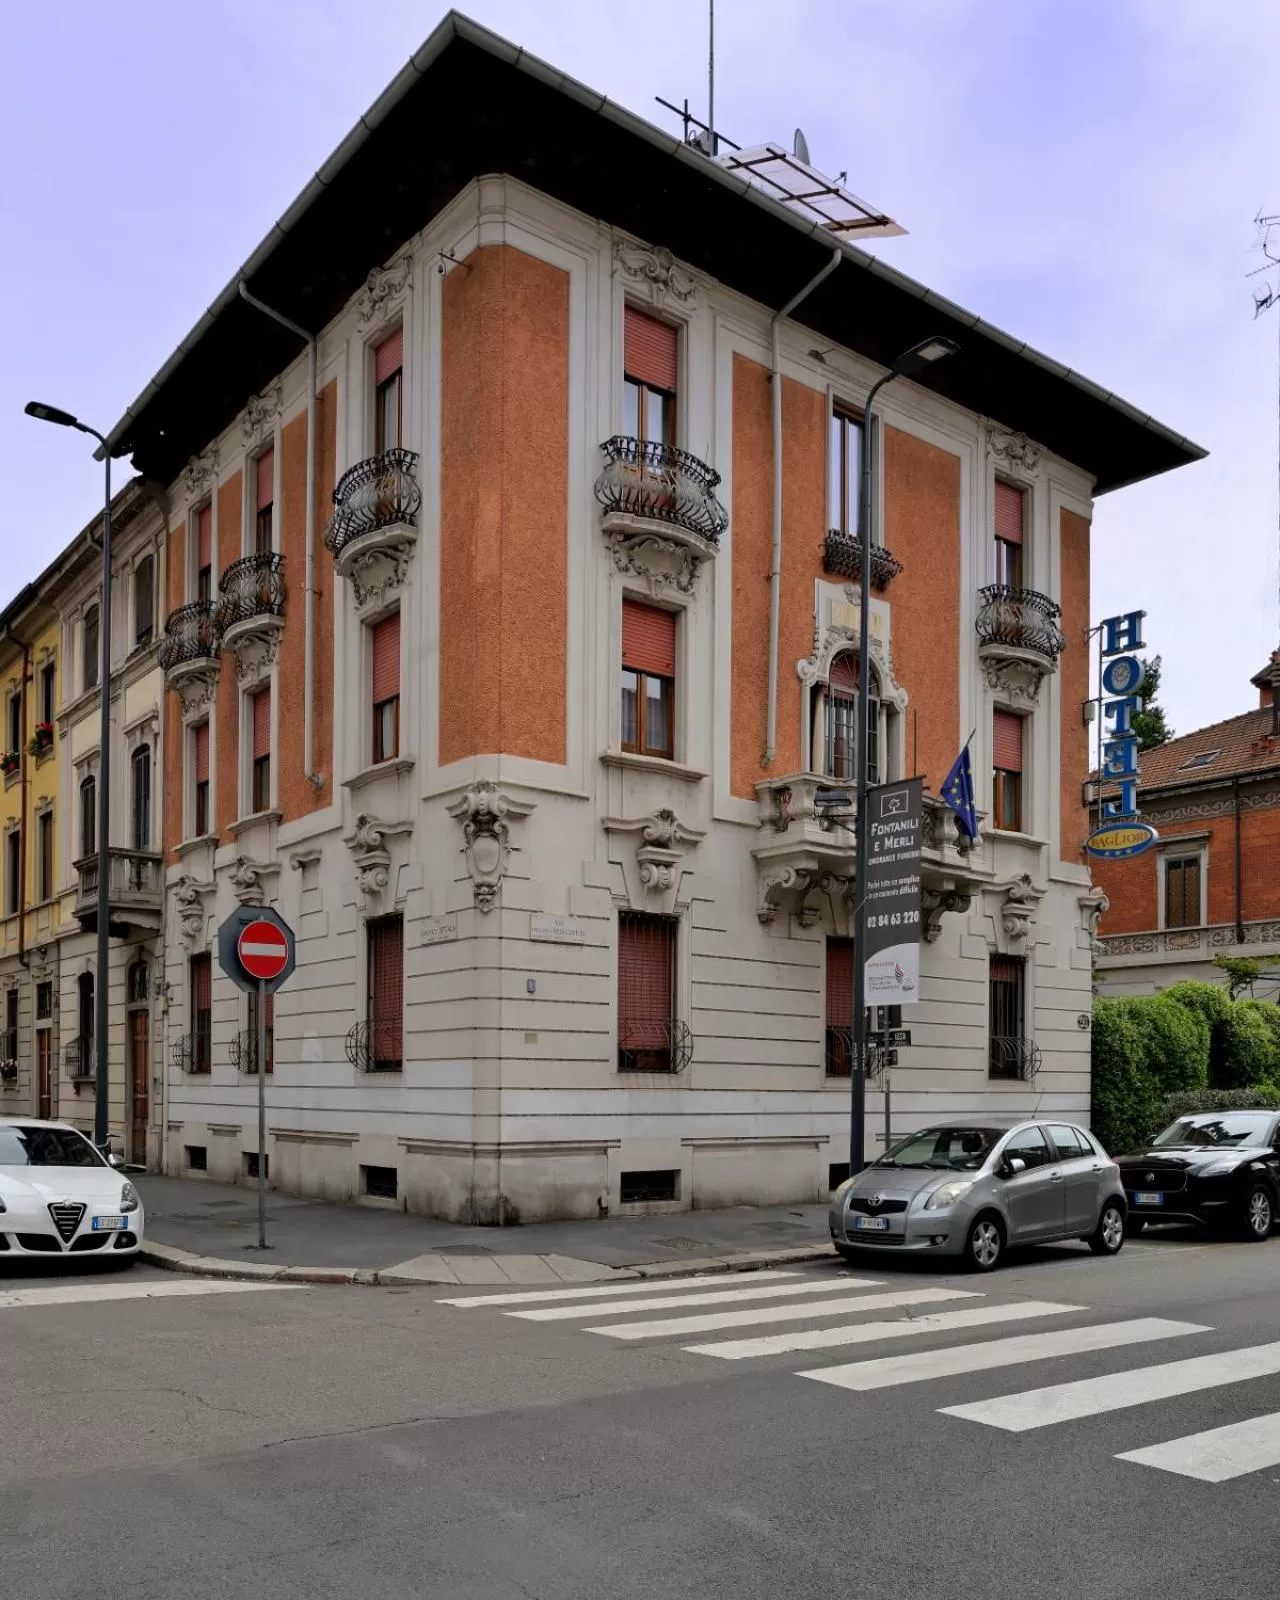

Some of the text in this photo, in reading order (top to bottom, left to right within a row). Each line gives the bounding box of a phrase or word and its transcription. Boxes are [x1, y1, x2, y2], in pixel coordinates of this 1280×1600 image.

[871, 818, 919, 836] FONTANILI
[874, 835, 914, 852] E MERLI
[1091, 830, 1148, 848] BAGLIORI
[867, 911, 920, 928] 02 84 63 220
